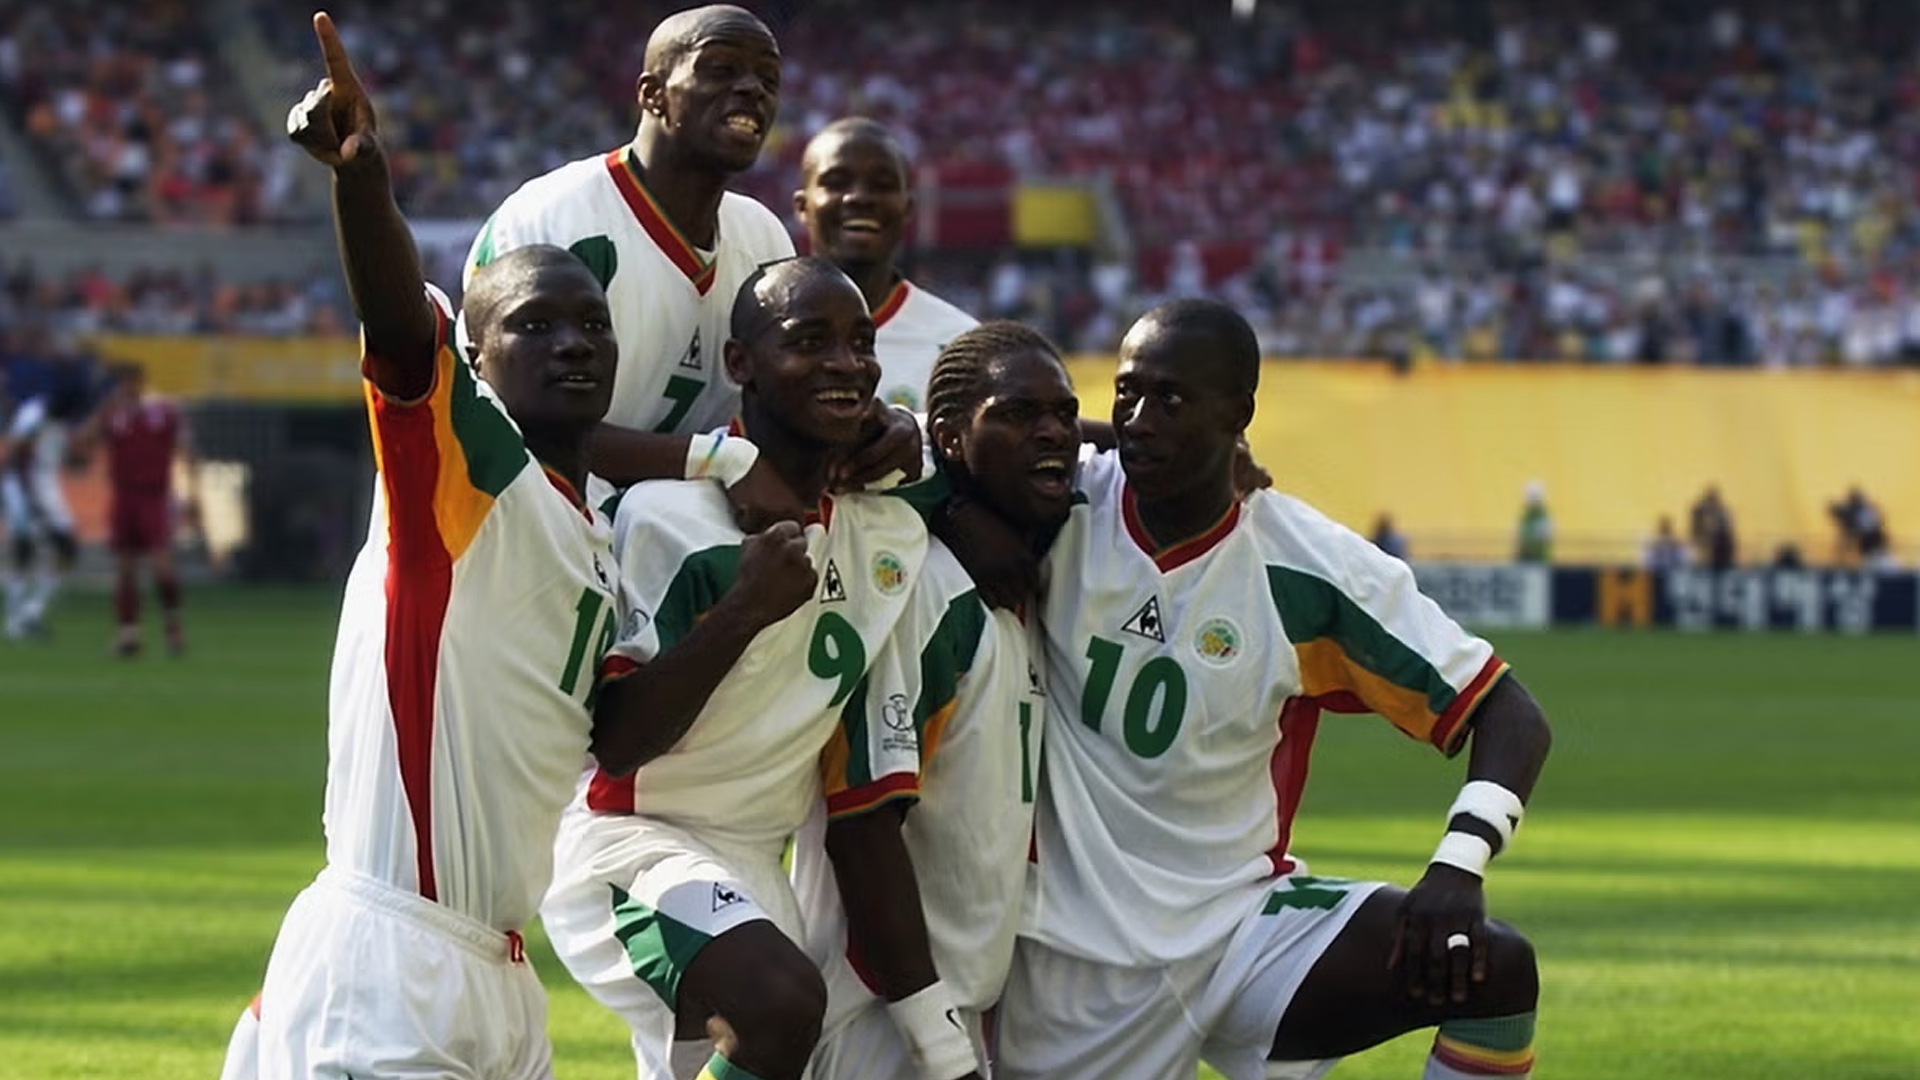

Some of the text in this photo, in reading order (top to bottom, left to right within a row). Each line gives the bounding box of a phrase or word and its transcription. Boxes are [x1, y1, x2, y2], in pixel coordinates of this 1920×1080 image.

[654, 374, 706, 433] 7
[808, 611, 866, 709] 9
[1081, 635, 1188, 760] 10
